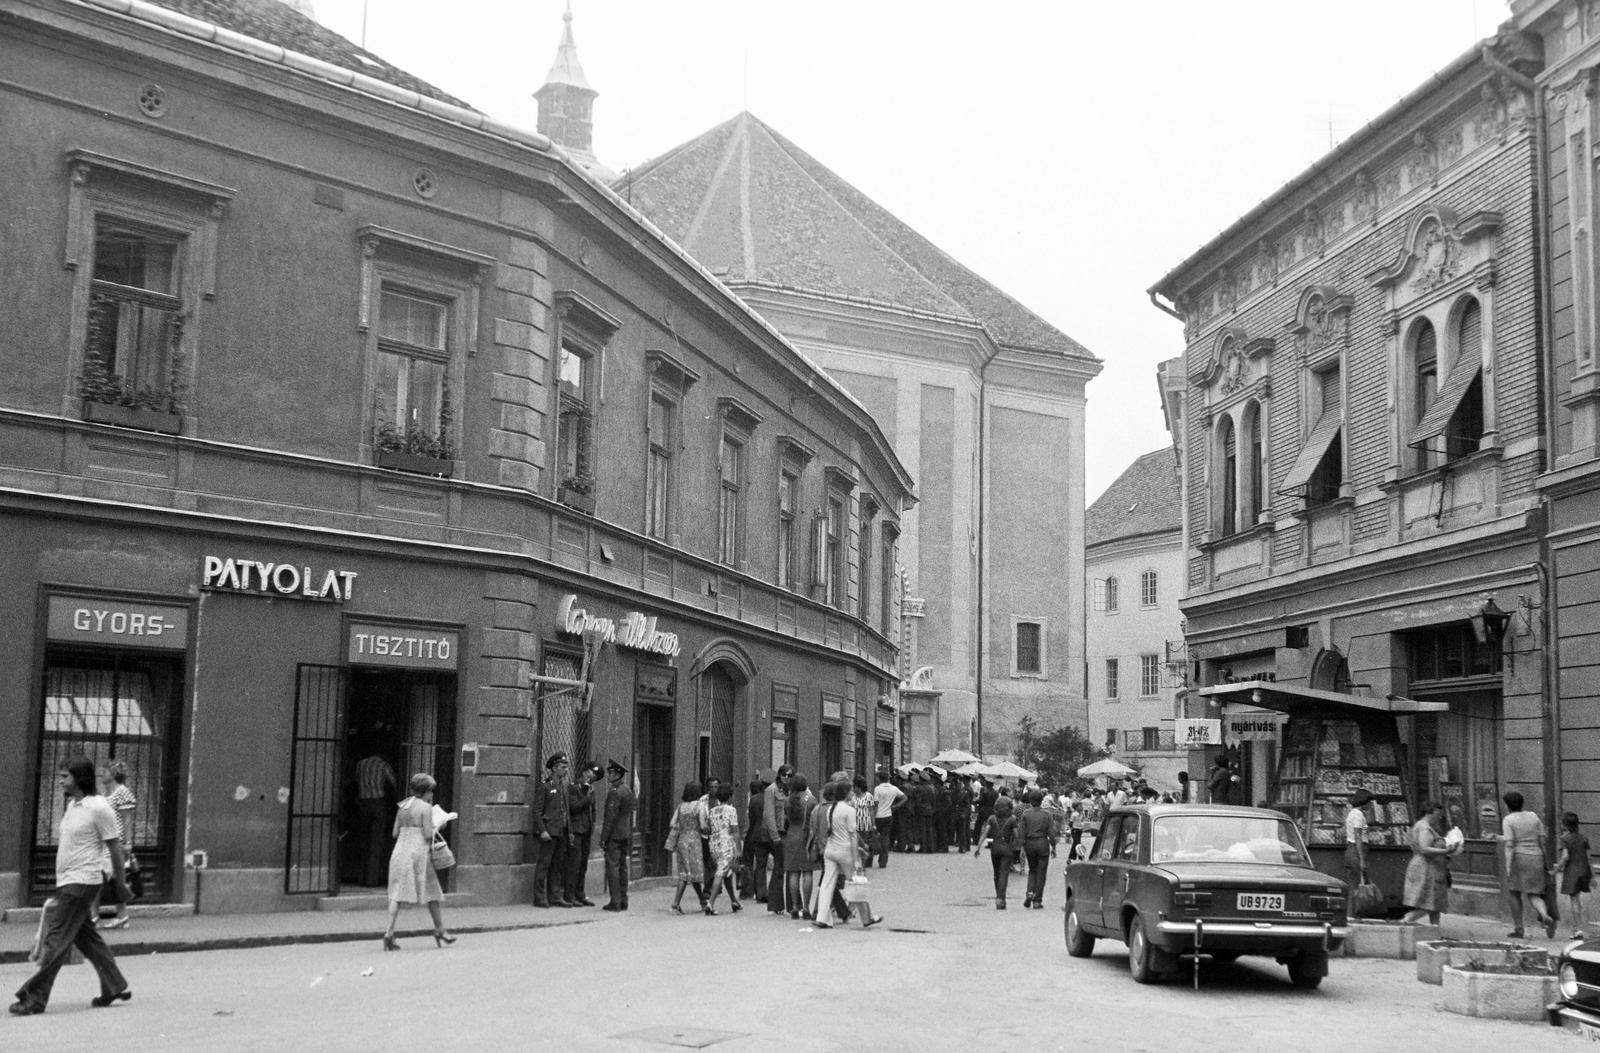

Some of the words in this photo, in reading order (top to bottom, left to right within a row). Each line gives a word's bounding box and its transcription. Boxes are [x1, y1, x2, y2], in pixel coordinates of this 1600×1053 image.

[203, 555, 359, 600] PATYOLAT
[73, 608, 175, 636] GYORS-
[355, 633, 450, 660] TISZTITÓ
